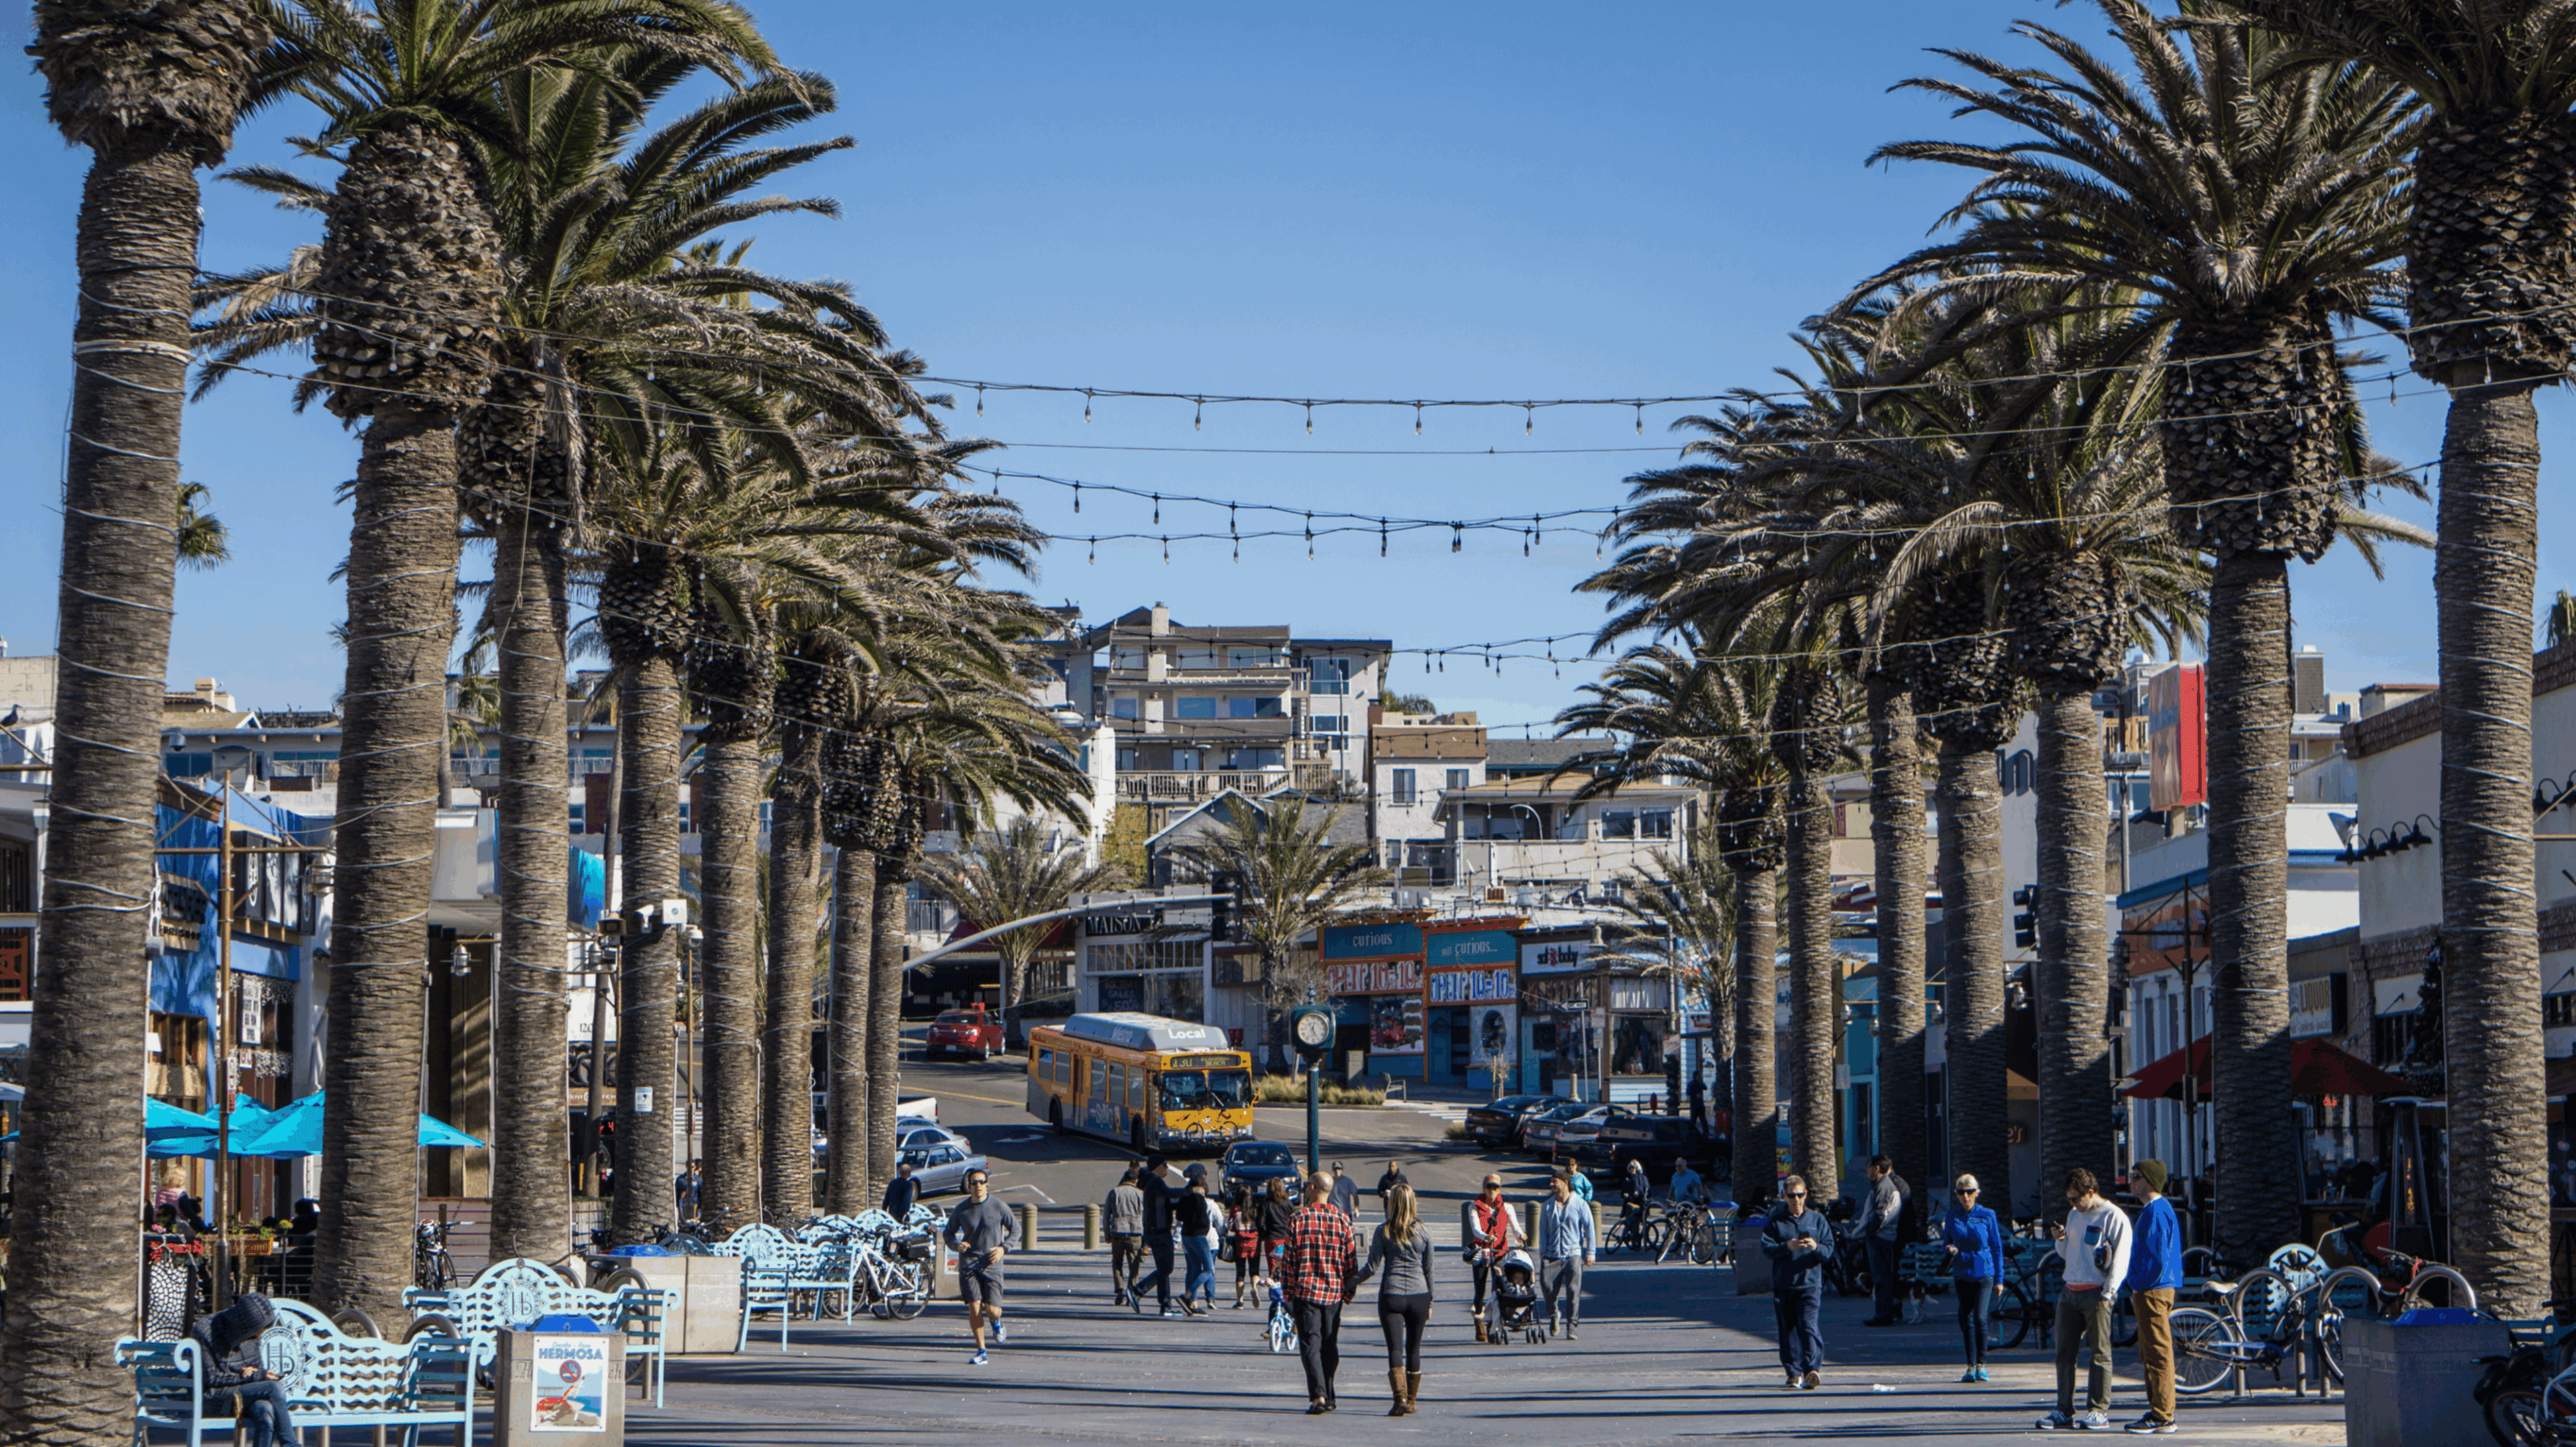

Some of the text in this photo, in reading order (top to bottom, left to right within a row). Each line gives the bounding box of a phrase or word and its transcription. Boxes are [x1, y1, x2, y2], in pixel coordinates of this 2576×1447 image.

[1087, 916, 1142, 934] MAISON
[1352, 932, 1393, 947] curious
[2300, 979, 2330, 1016] LIQUOR
[1168, 1028, 1206, 1040] Local
[1173, 1057, 1193, 1068] 130
[539, 1348, 603, 1360] HERMOSA
